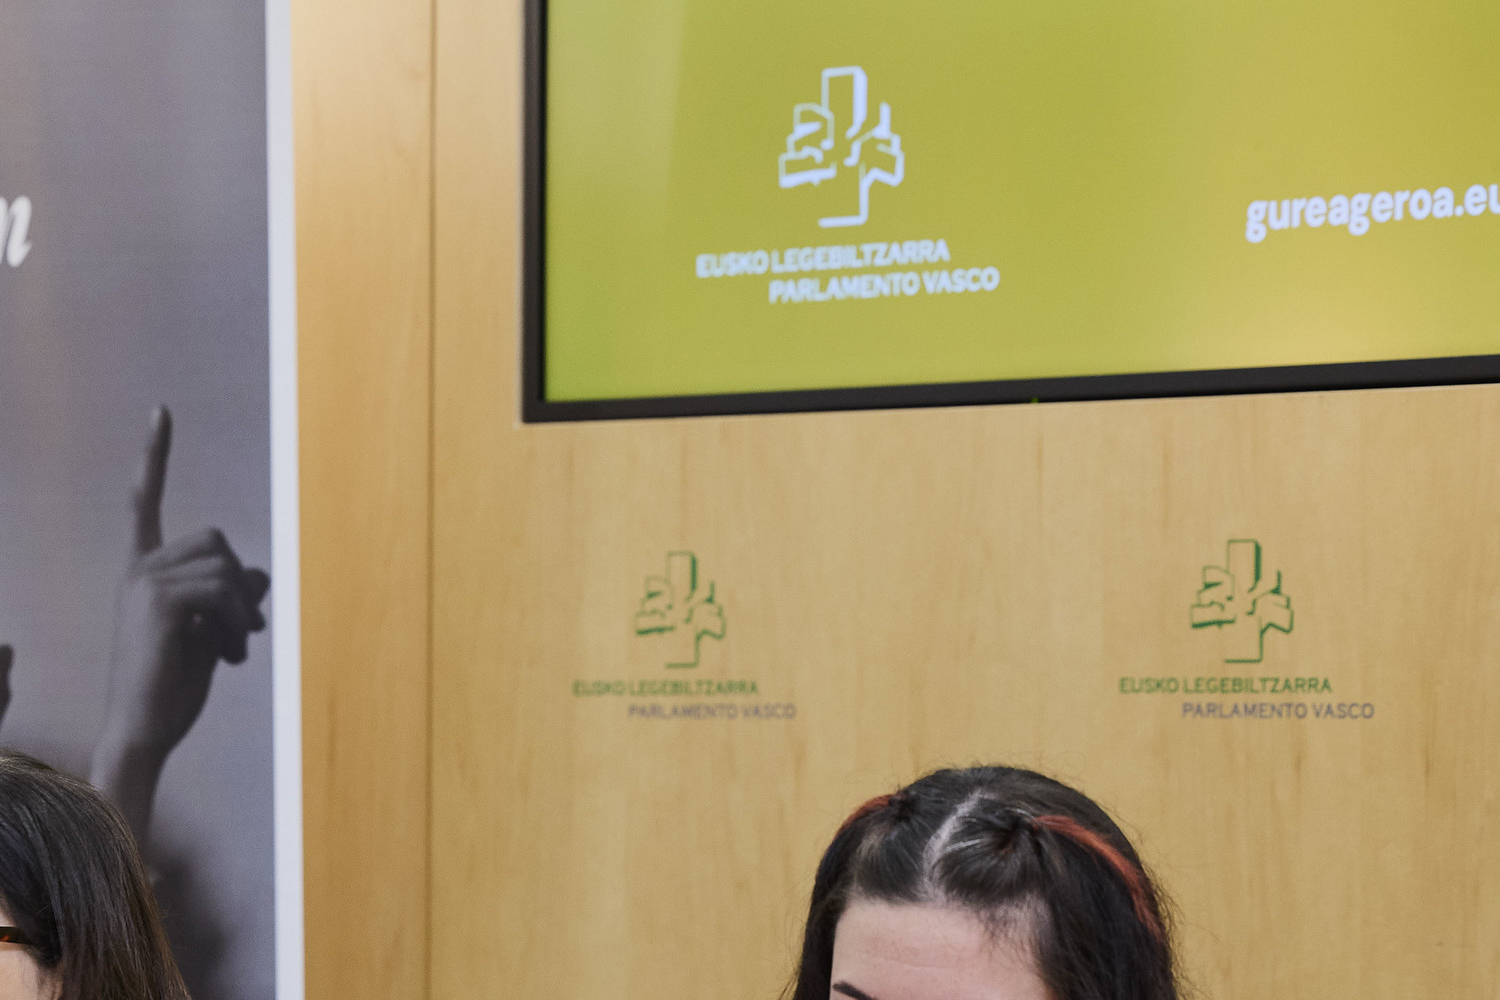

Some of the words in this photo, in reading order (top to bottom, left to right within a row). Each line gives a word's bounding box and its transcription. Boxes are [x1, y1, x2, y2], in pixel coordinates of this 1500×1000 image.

[695, 249, 769, 278] EUSKO
[770, 238, 950, 273] LEGEBILTZARRA
[768, 271, 920, 304] PARLAMENTO
[922, 266, 1000, 294] VASCO
[572, 679, 626, 697] EUSKO
[627, 678, 759, 697] LEGEBILTZARRA
[1118, 677, 1179, 693] EUSKO
[1183, 677, 1332, 693] LEGEBILTZARRA
[628, 702, 739, 720] PARLAMENTO
[741, 702, 797, 720] VASCO
[1181, 702, 1308, 719] PARLAMENTO
[1311, 702, 1375, 719] VASCO
